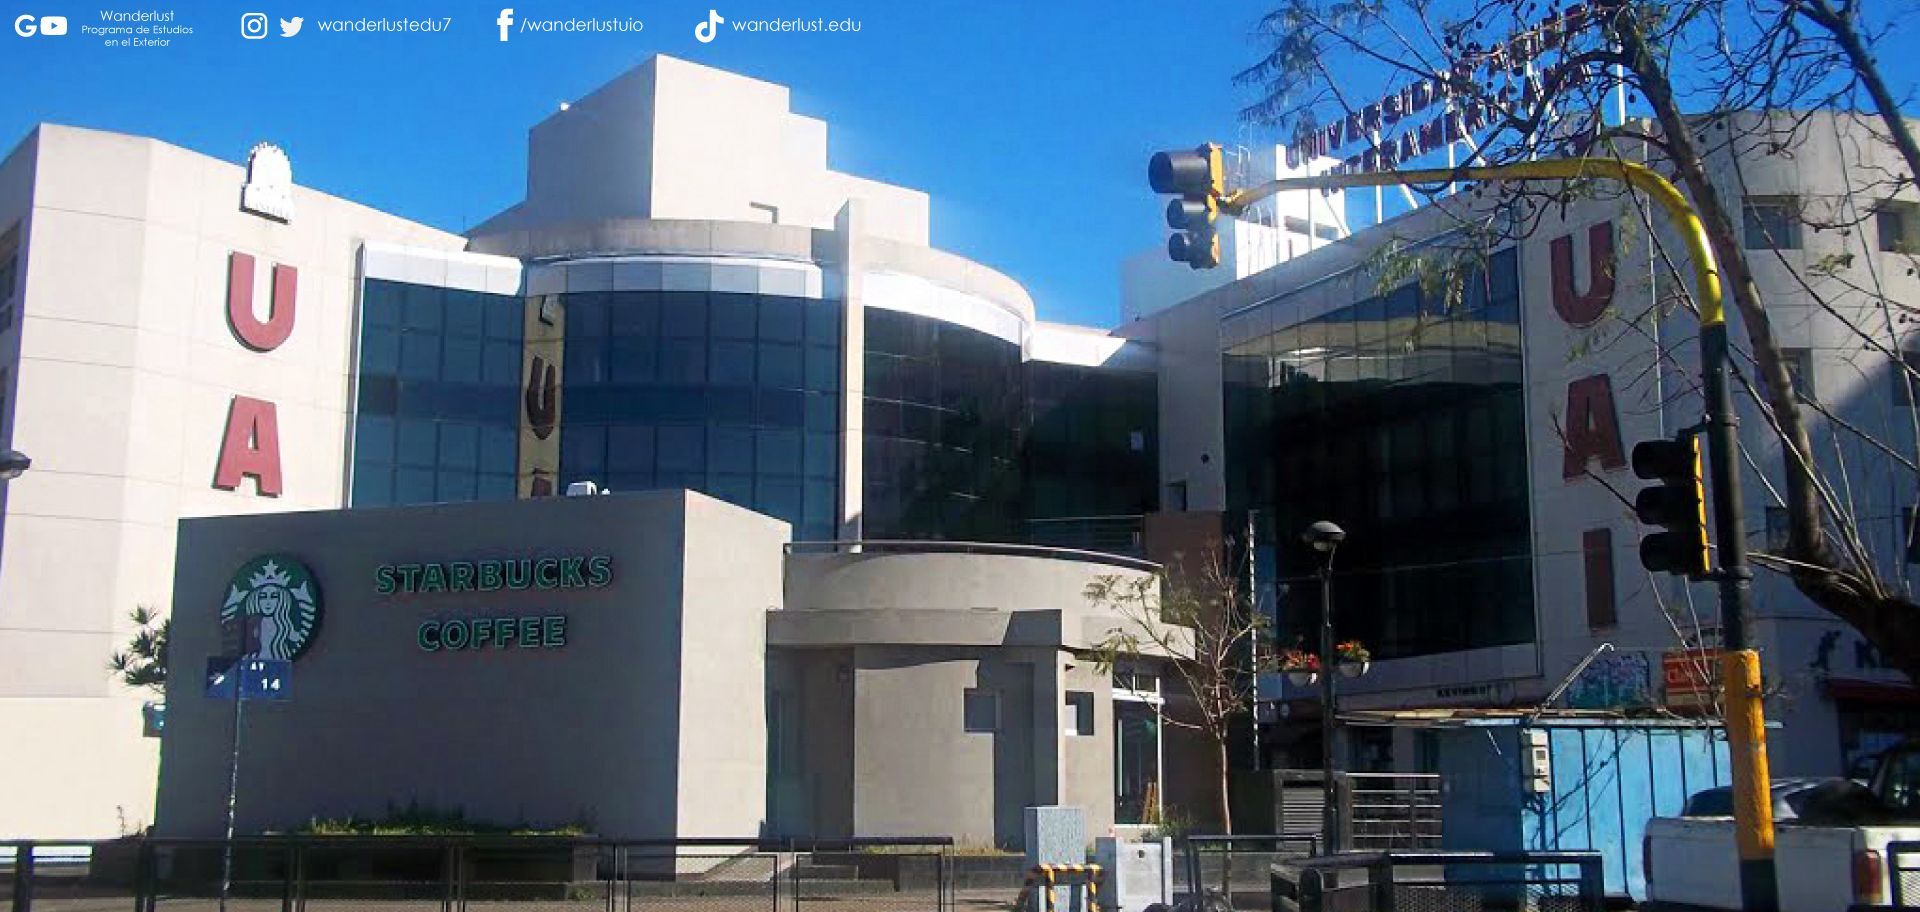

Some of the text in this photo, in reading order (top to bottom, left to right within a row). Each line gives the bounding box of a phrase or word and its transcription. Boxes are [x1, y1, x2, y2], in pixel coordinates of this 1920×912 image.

[375, 556, 614, 595] STARBUCKS
[416, 616, 569, 651] COFFEE
[261, 677, 281, 691] 14
